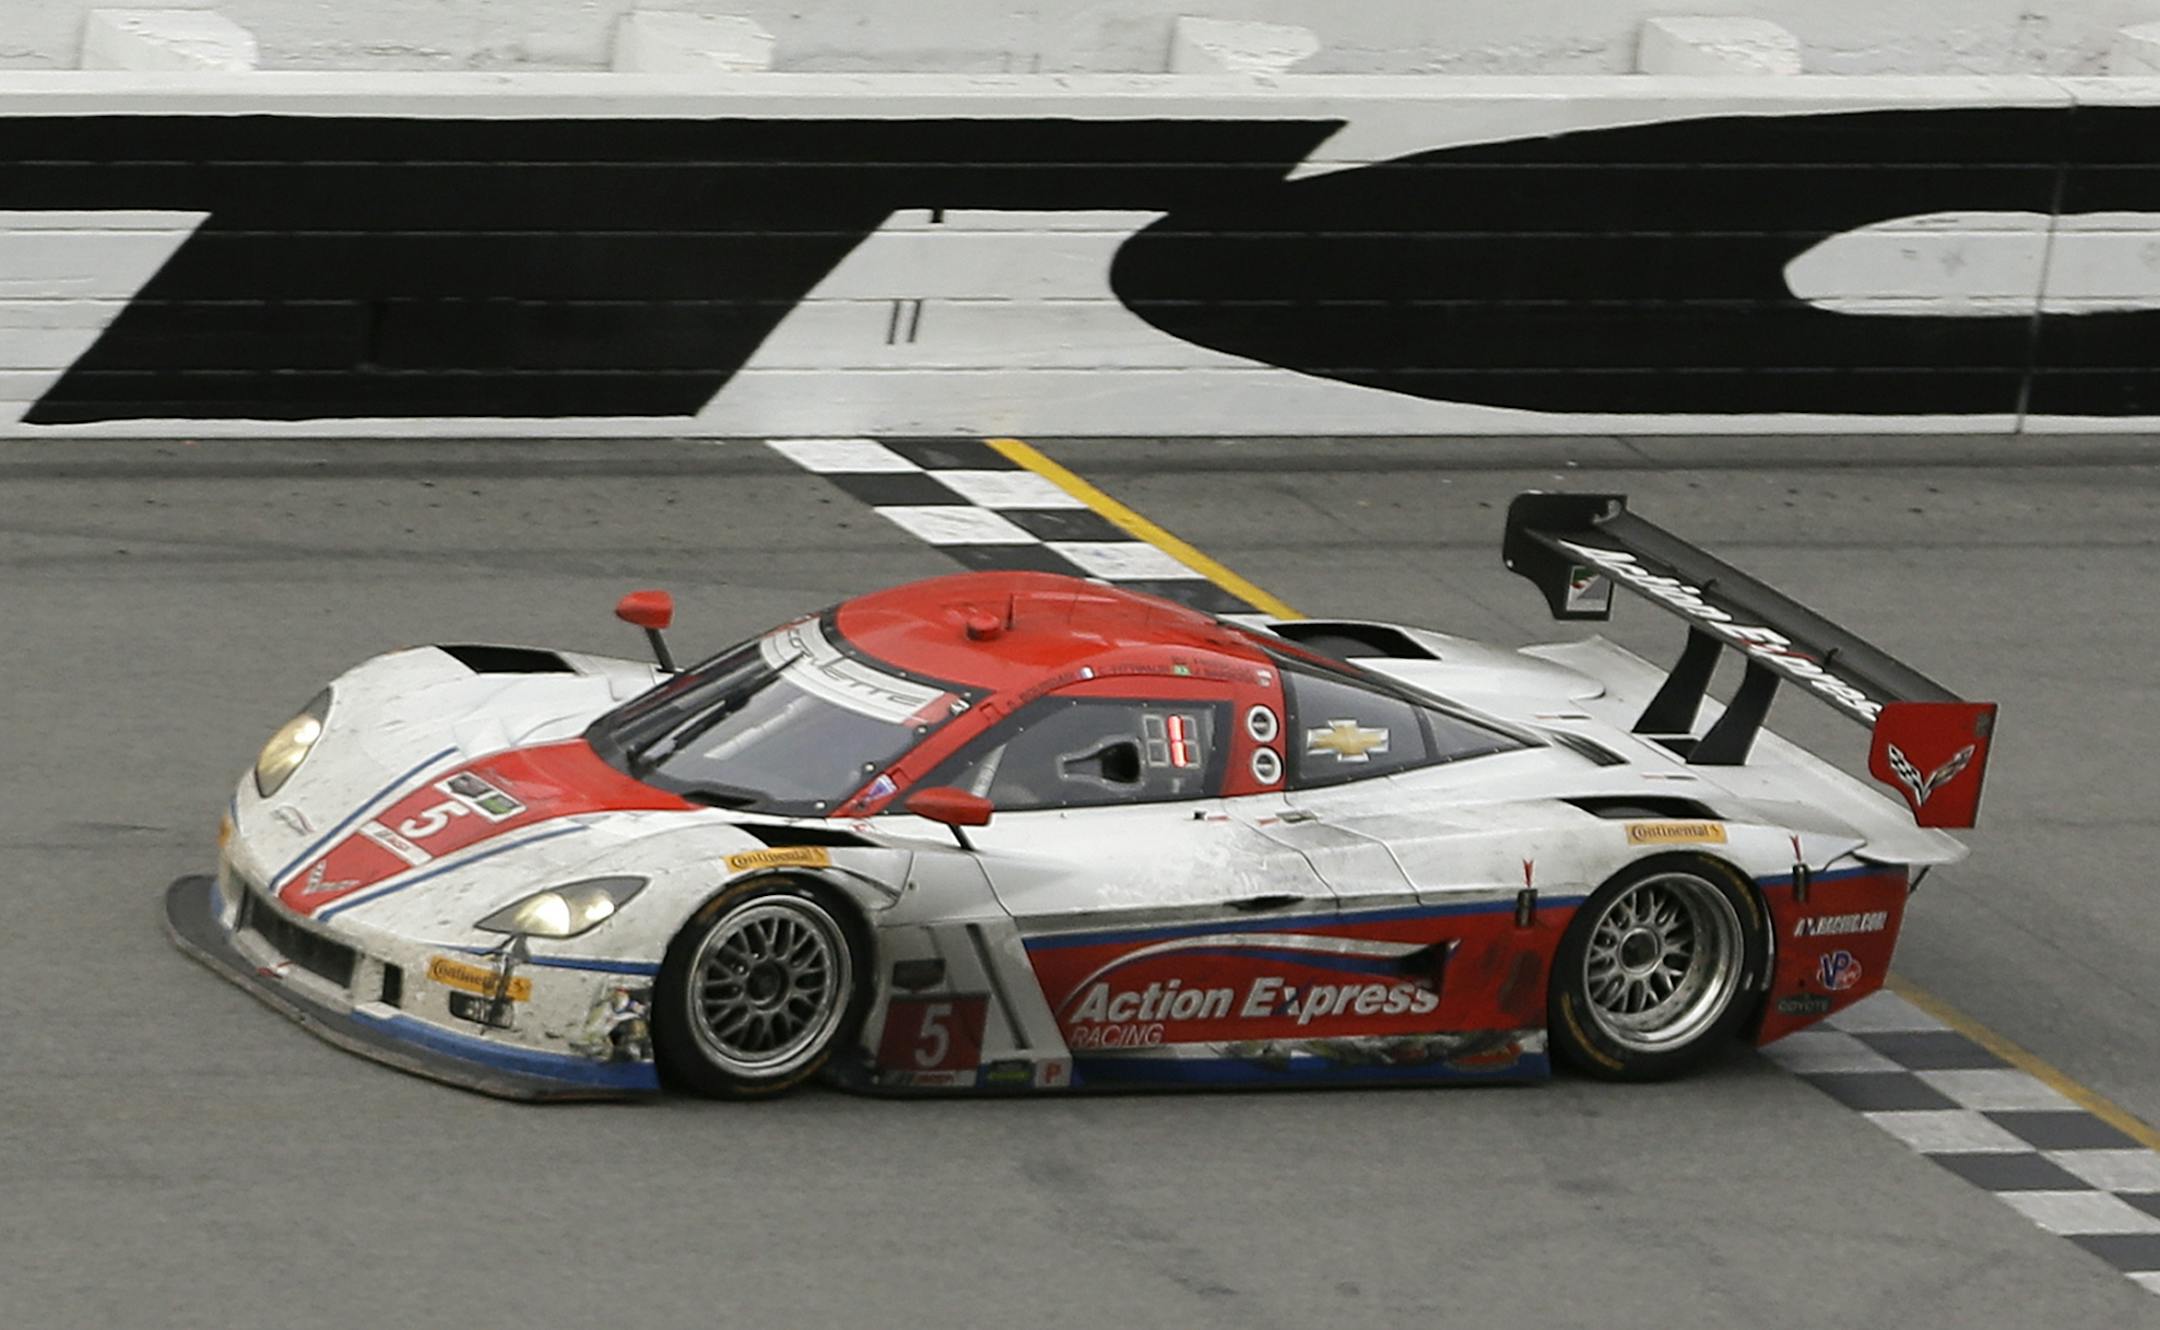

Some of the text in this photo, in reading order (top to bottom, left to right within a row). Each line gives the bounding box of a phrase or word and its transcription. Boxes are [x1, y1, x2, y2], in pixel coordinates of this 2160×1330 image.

[1708, 619, 1883, 722] Expres
[400, 801, 470, 838] 5
[1632, 822, 1710, 841] Continental
[731, 848, 812, 868] Continental
[1821, 951, 1851, 990] VP
[1070, 976, 1440, 1025] Action Express
[915, 1003, 953, 1067] 5
[1071, 1023, 1165, 1049] RACING
